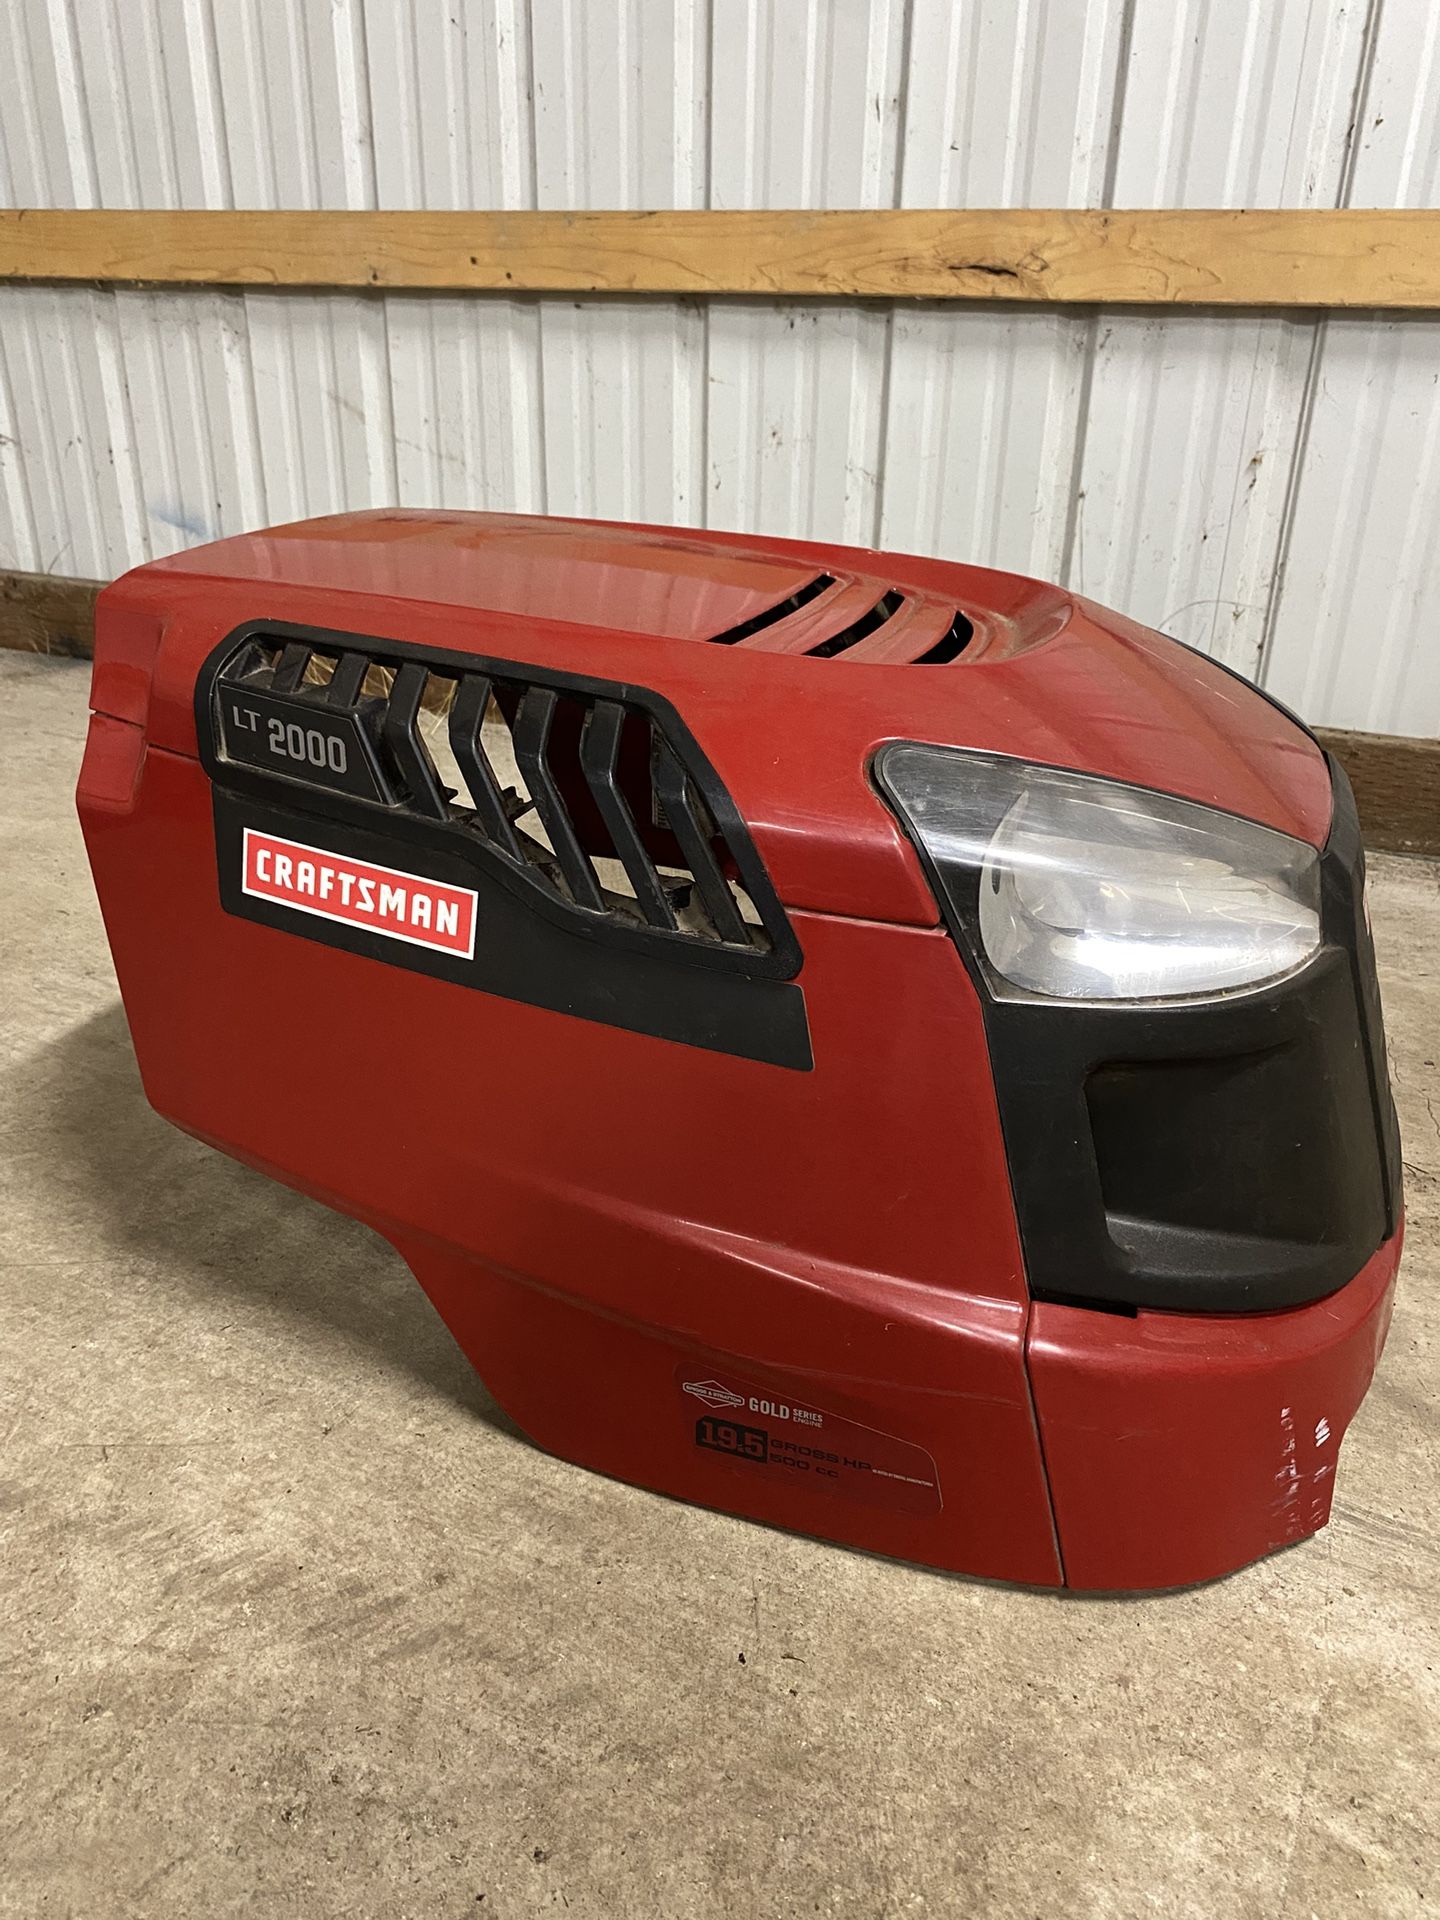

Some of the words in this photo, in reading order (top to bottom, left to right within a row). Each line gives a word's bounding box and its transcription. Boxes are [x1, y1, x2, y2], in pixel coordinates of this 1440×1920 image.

[232, 706, 261, 732] LT
[268, 718, 348, 774] 2000
[256, 849, 459, 936] CRAFTSMAN
[749, 1397, 790, 1419] GOLD
[792, 1408, 823, 1422] SERIES
[793, 1416, 823, 1428] ENGINE
[702, 1421, 764, 1457] 19.5
[771, 1440, 839, 1463] GROSS
[843, 1457, 872, 1470] HP
[769, 1453, 810, 1470] 500
